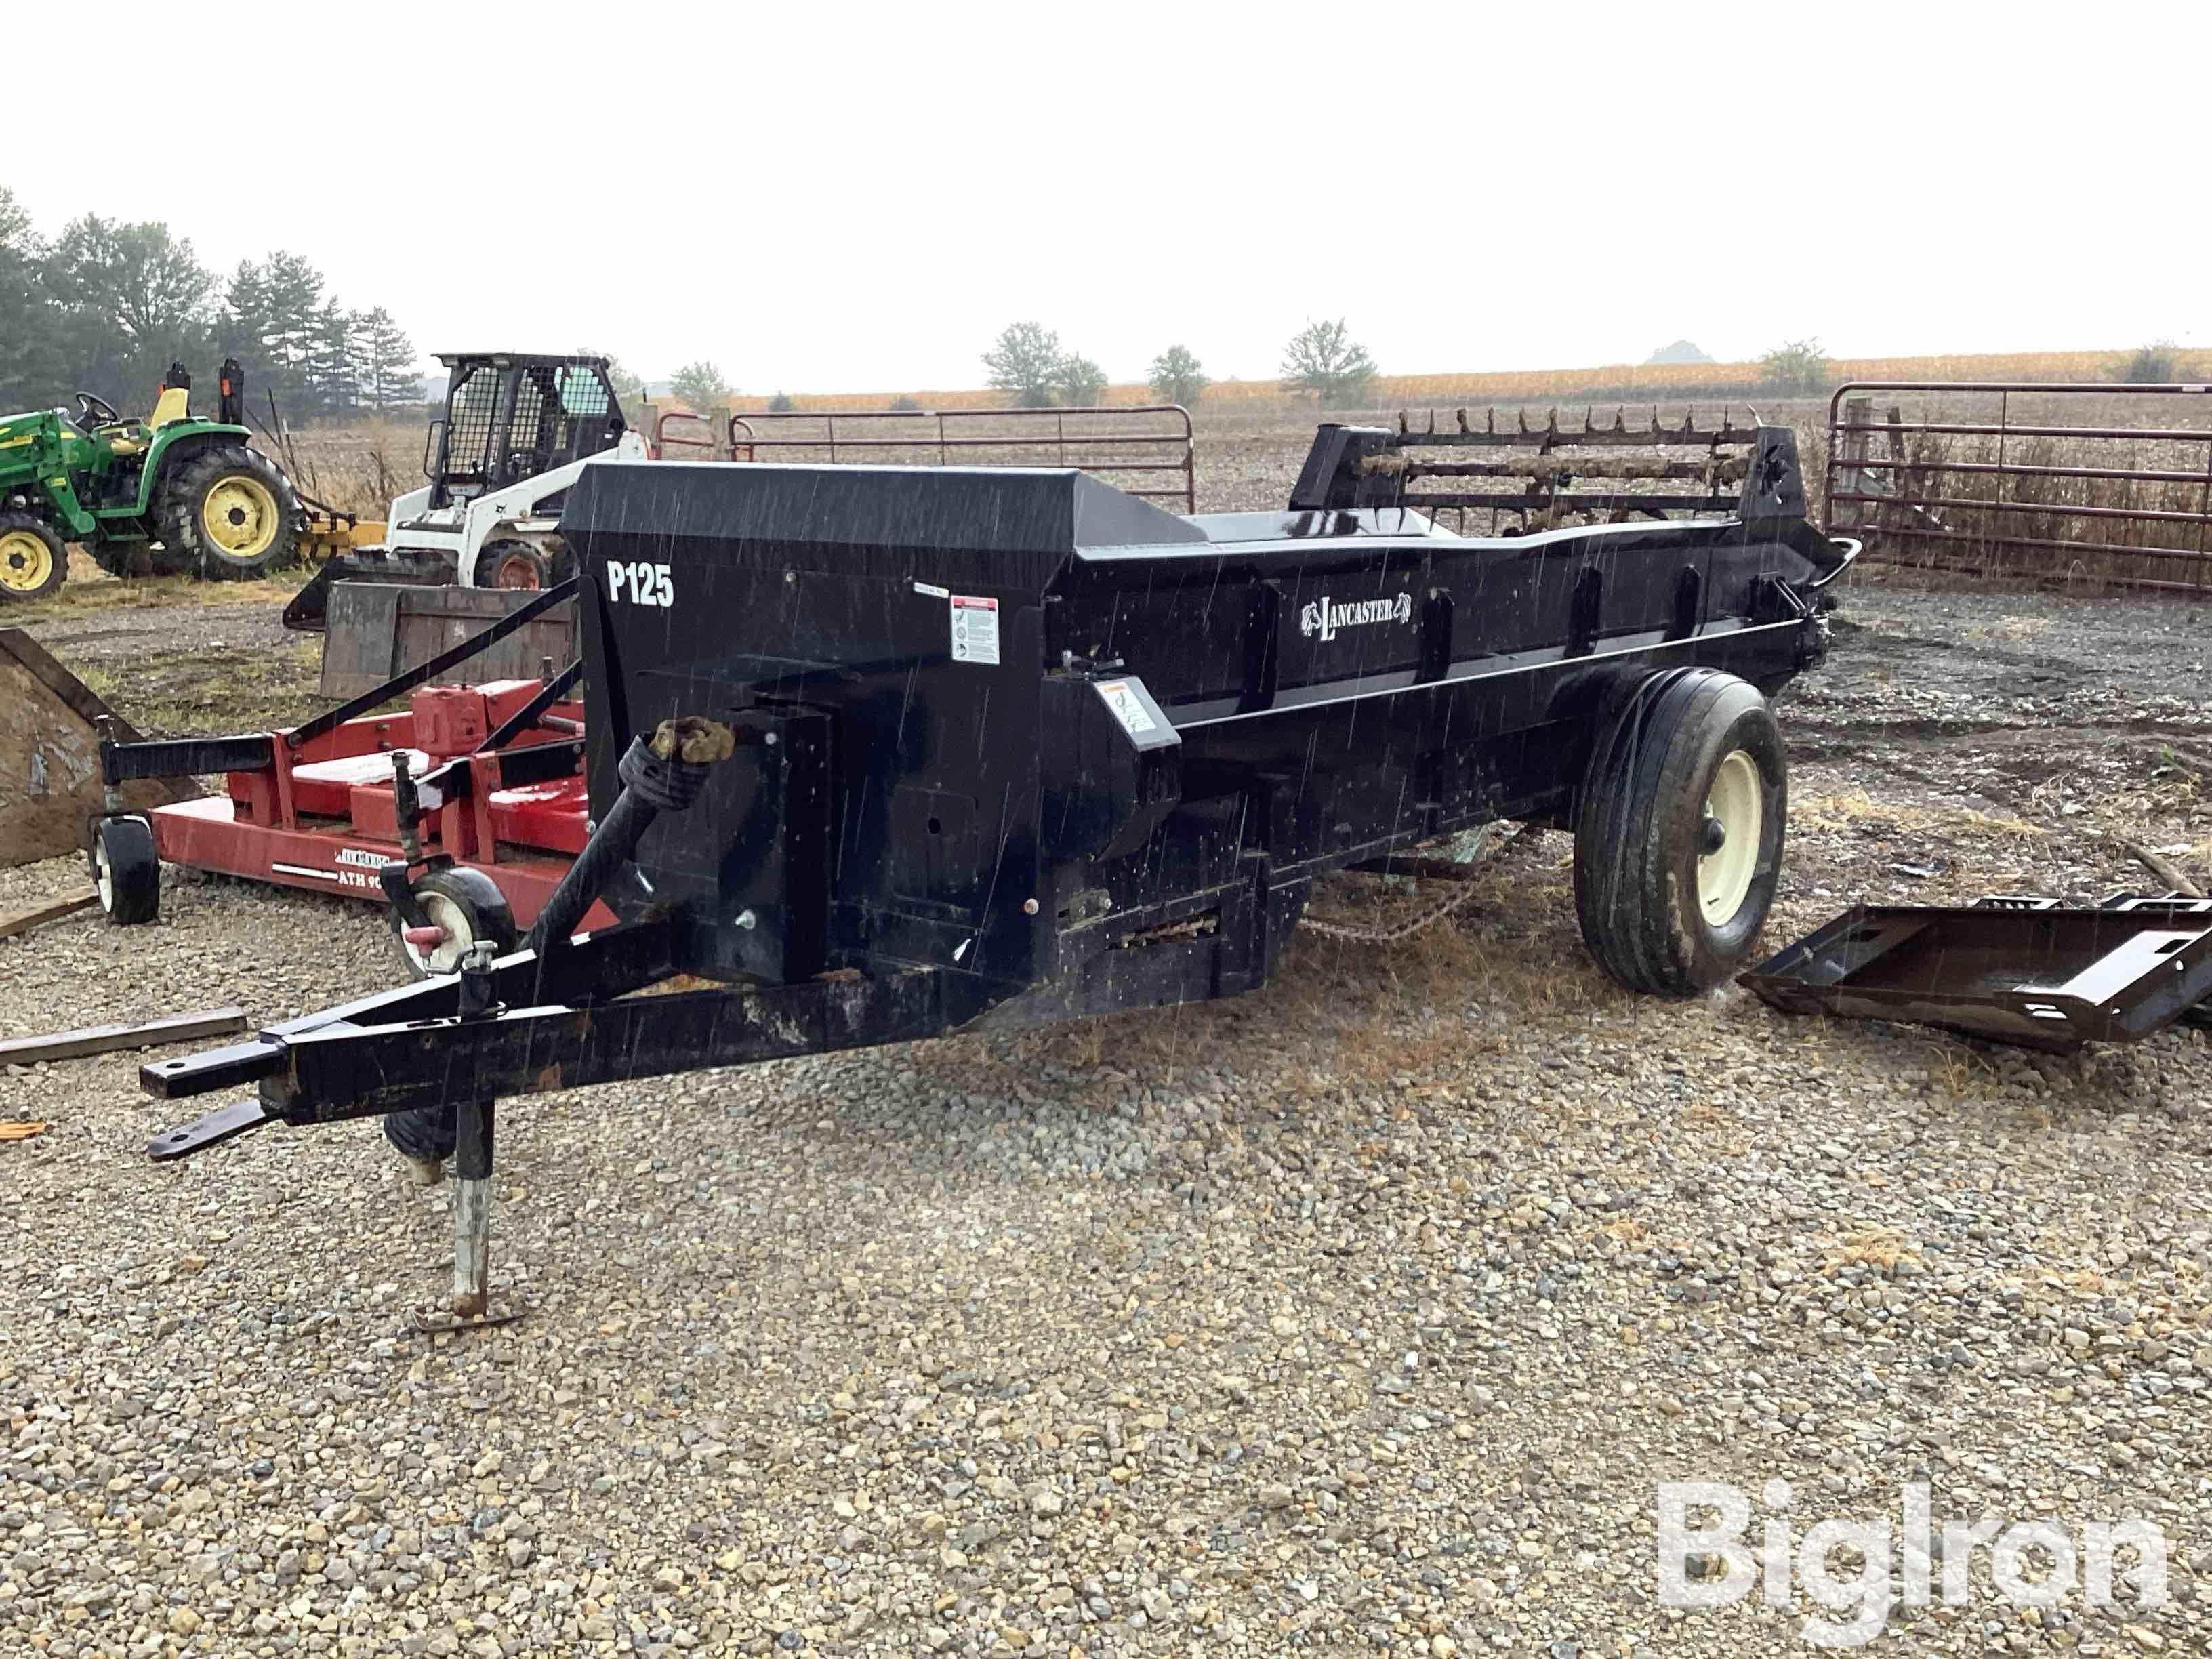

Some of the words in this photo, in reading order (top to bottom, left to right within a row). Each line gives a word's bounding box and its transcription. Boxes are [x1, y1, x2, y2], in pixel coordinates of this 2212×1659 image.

[607, 560, 674, 607] P125
[1321, 596, 1393, 640] LANCASTER
[339, 870, 366, 887] ATH
